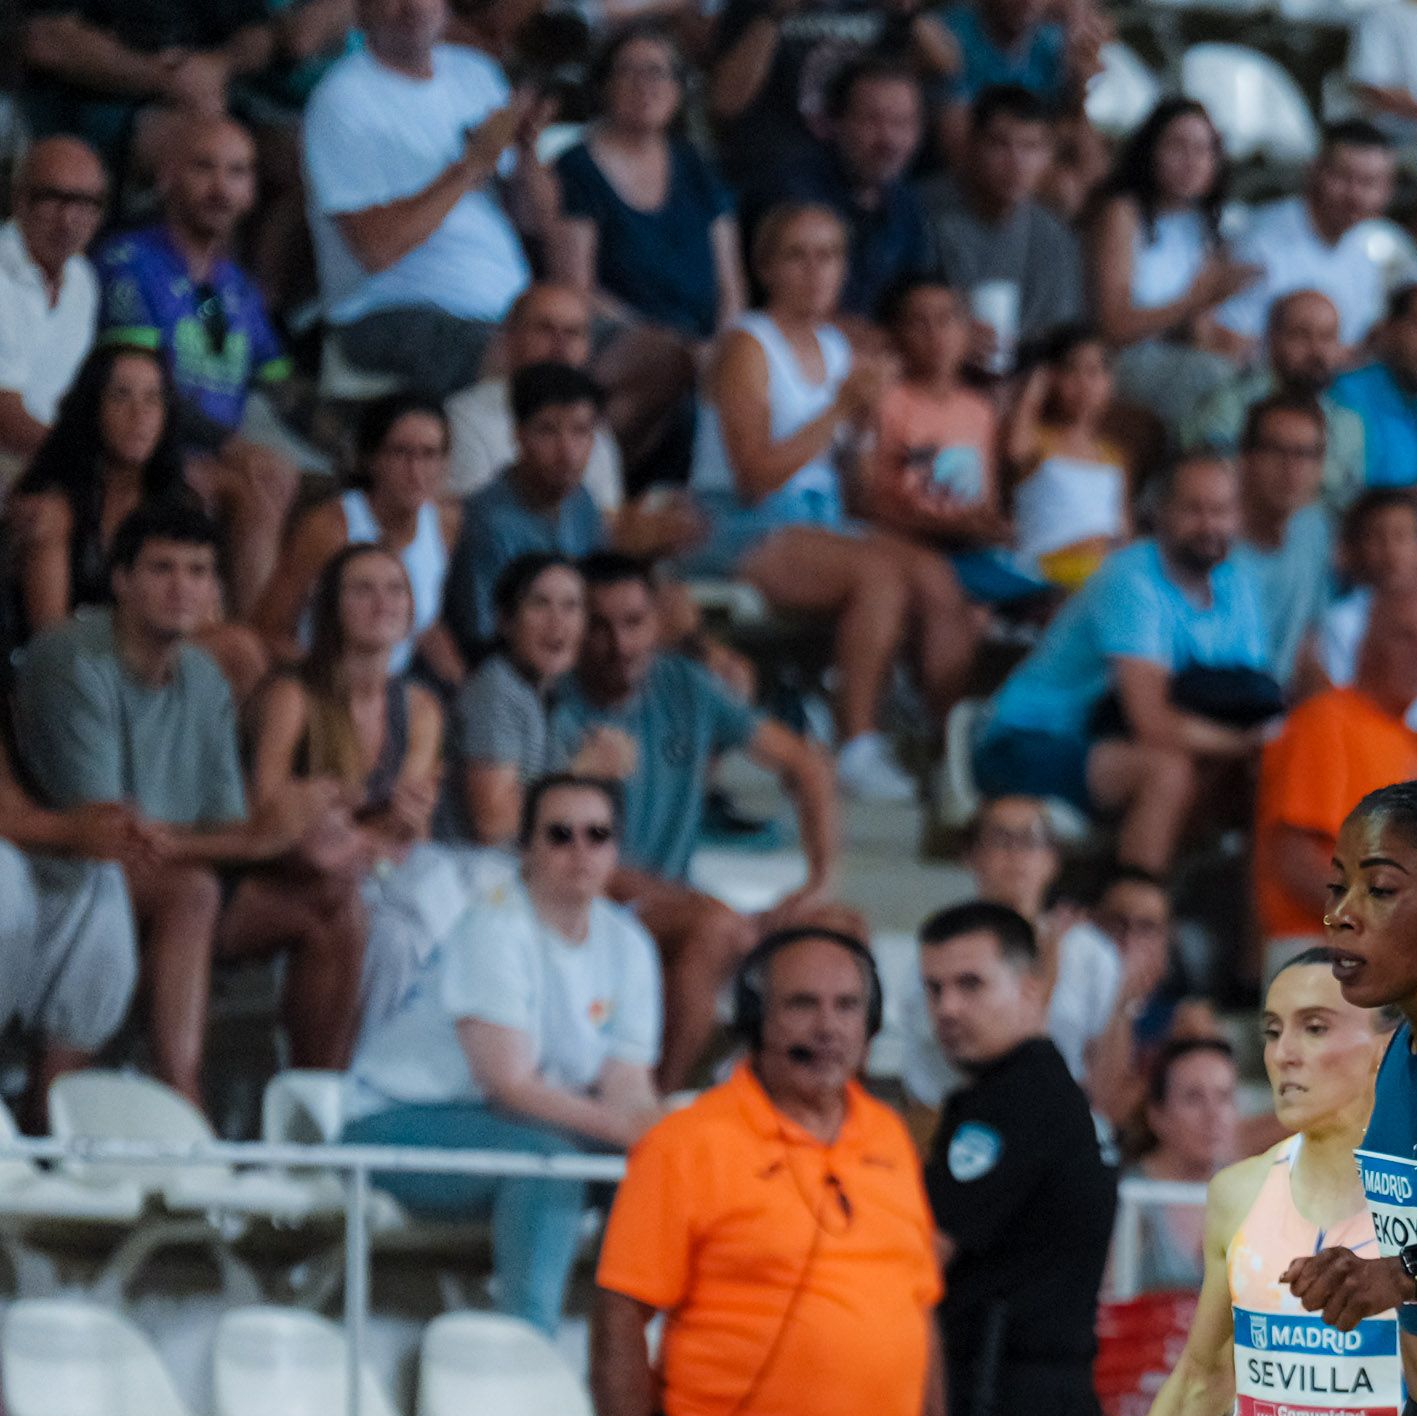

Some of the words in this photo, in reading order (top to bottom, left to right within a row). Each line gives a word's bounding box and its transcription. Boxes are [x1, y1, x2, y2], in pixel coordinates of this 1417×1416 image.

[1364, 1169, 1413, 1203] MADRID
[1271, 1324, 1362, 1357] MADRID
[1248, 1359, 1375, 1394] SEVILLA
